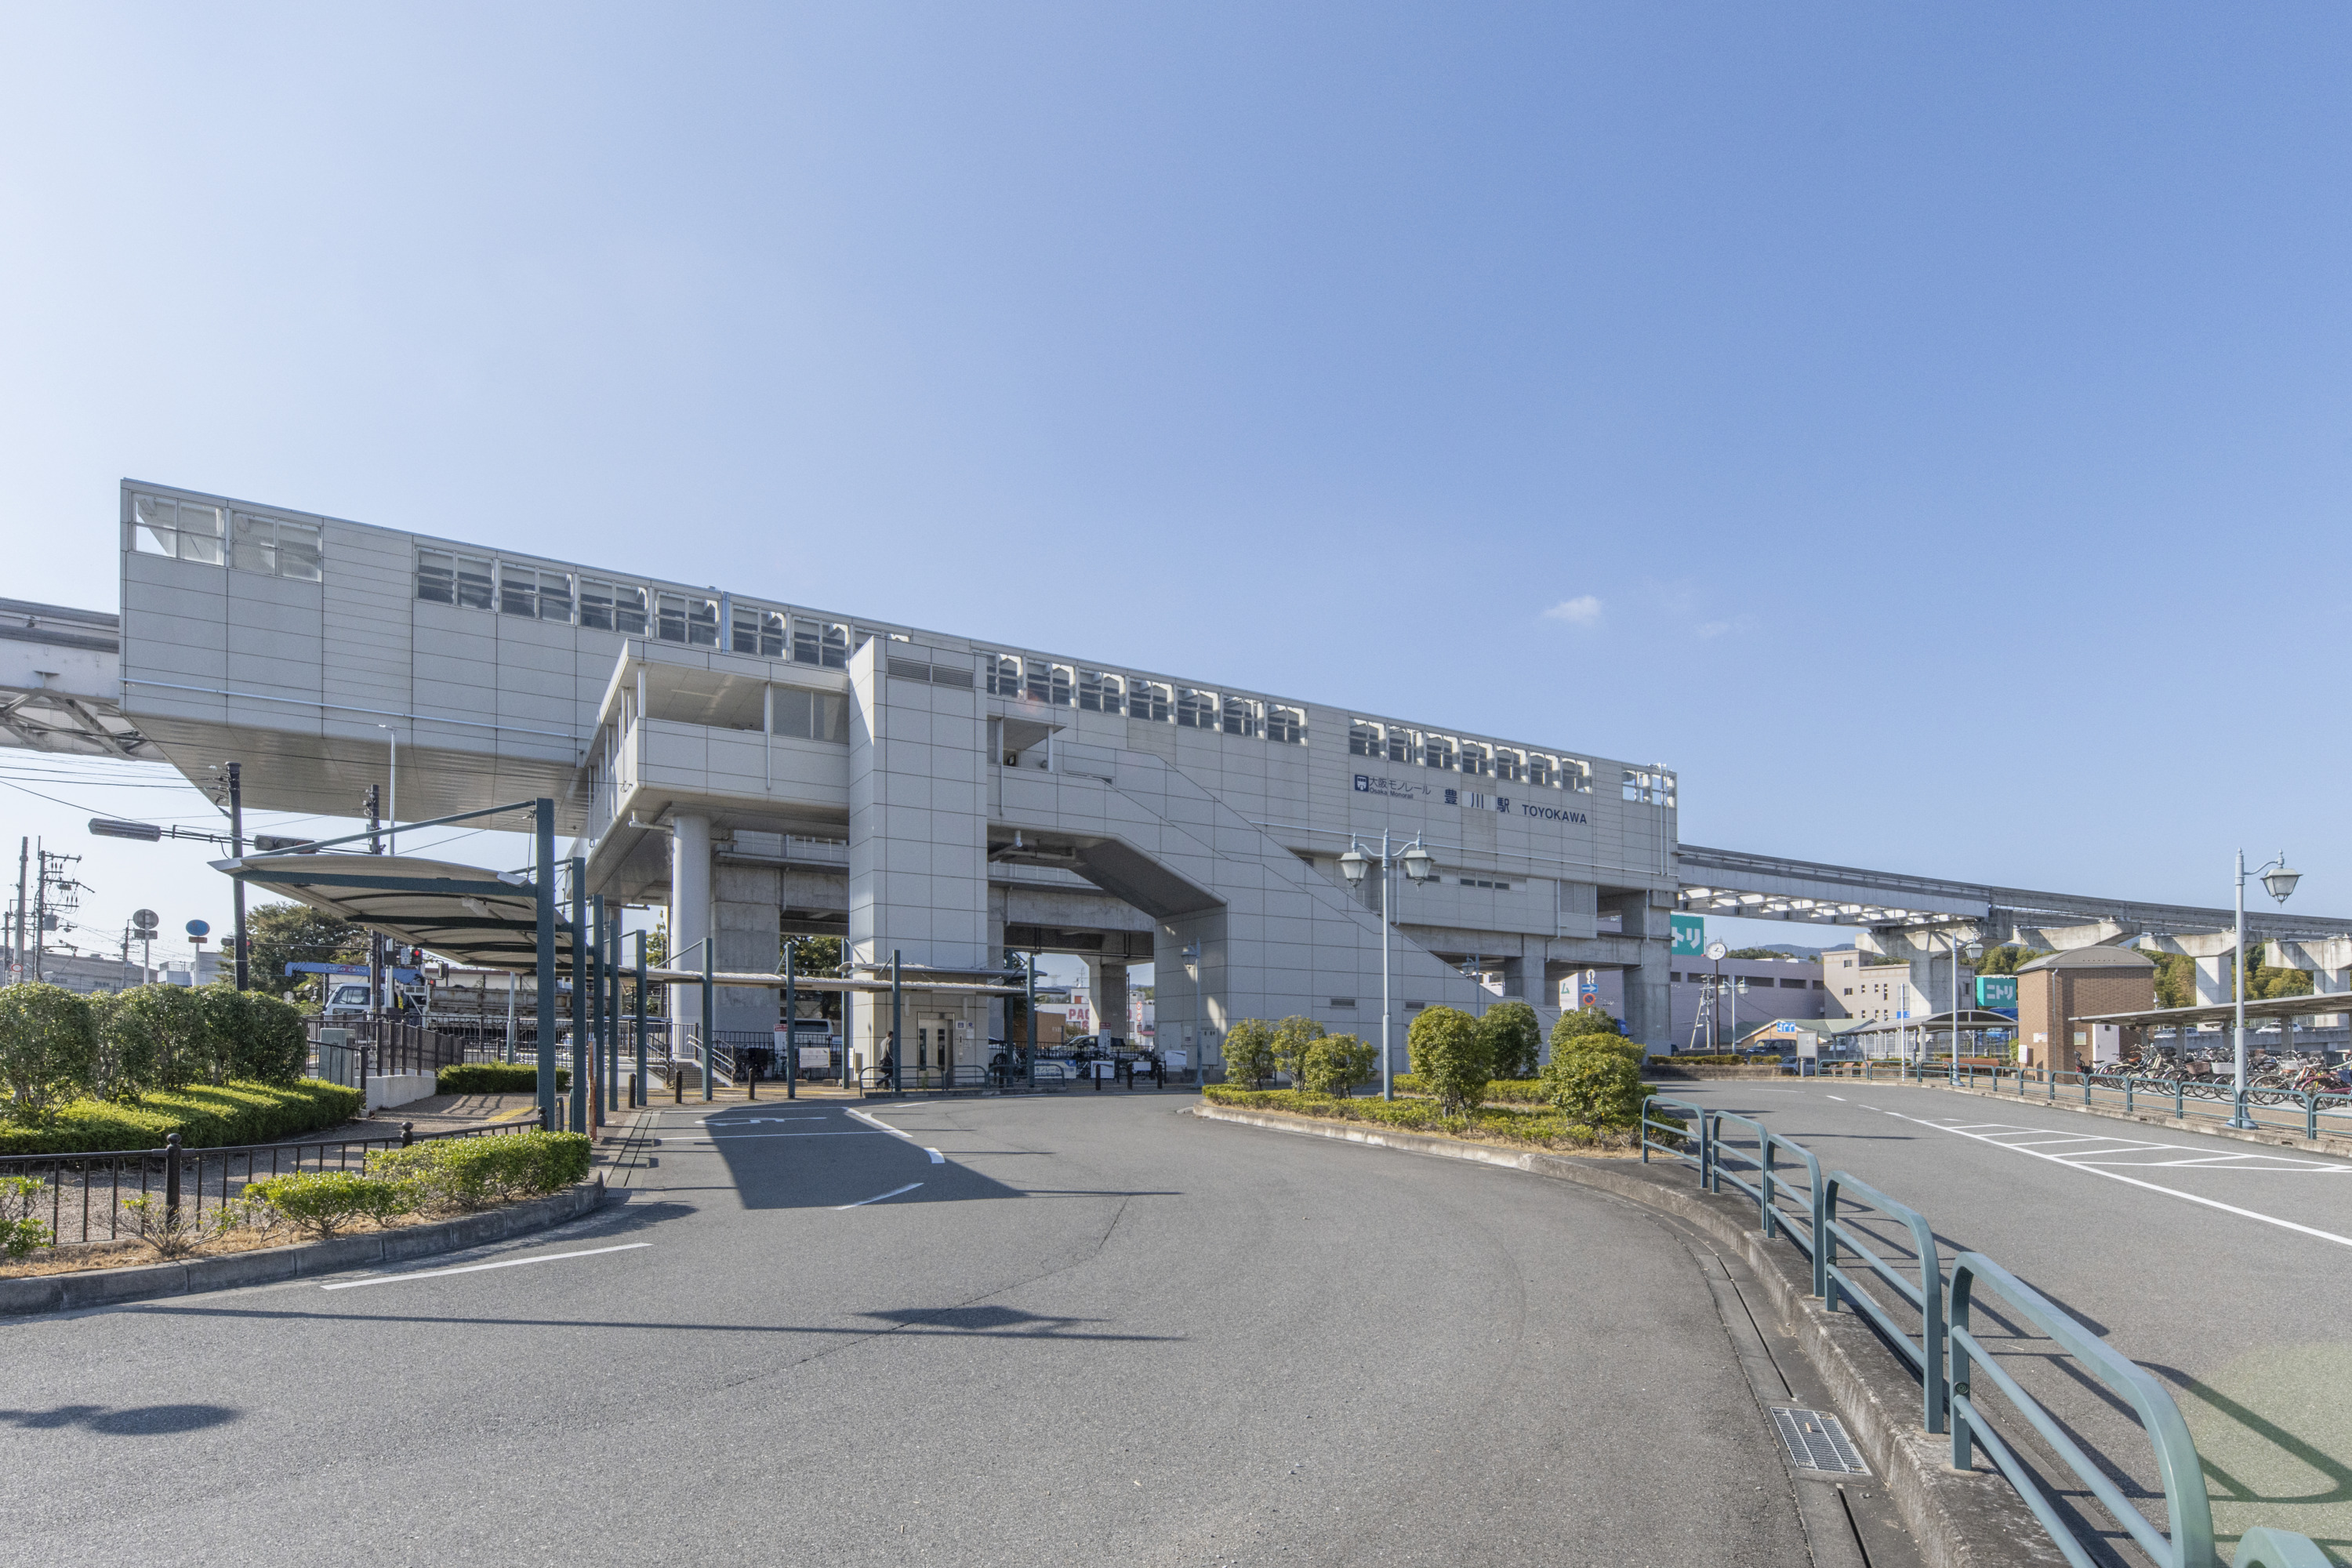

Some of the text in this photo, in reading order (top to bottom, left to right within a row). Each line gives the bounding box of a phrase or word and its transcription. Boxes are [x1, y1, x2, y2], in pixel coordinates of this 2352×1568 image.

[1369, 777, 1432, 795] 大阪モノレール
[1370, 787, 1414, 799] Osaka Monorail
[1444, 789, 1510, 813] 豊川駅
[1522, 804, 1588, 824] TOYOKAWA
[1987, 985, 2013, 1000] ニトリ
